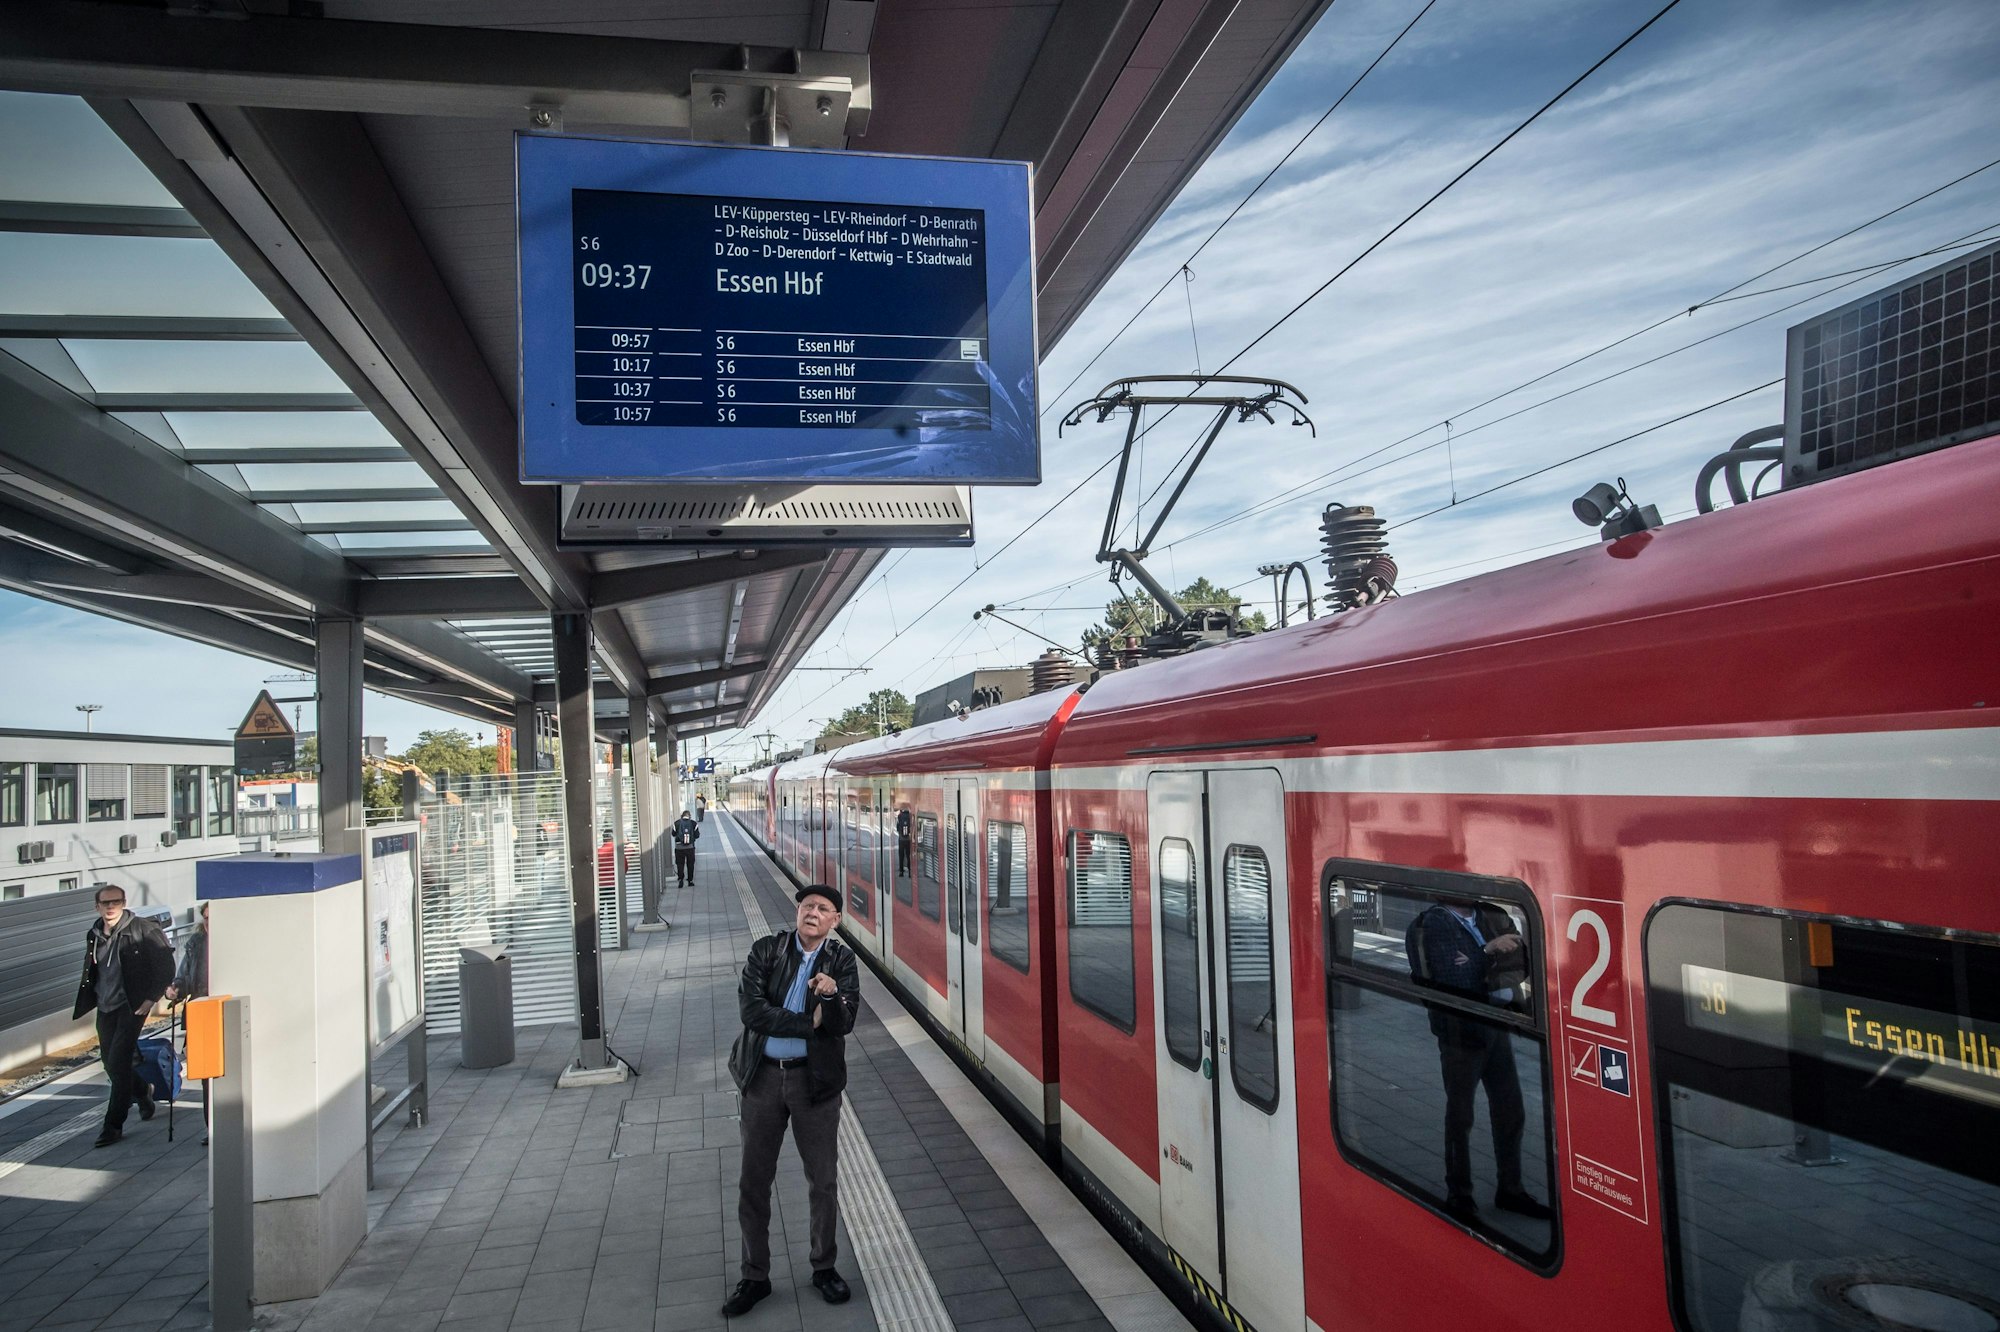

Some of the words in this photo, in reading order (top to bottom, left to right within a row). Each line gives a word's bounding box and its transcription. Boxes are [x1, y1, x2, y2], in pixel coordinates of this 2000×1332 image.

[714, 204, 810, 227] LEV-Küppersteg
[823, 210, 907, 227] LEV-Rheindorf
[919, 214, 977, 231] D-Benrath
[580, 236, 589, 250] S
[591, 236, 600, 251] 6
[726, 224, 790, 240] D-Reisholz
[802, 227, 865, 244] Düsseldorf
[867, 230, 889, 245] Hbf
[901, 232, 910, 246] D
[911, 232, 969, 248] Wehrhahn
[715, 242, 724, 256] D
[726, 242, 749, 257] Zoo
[763, 244, 837, 261] D-Derendorf
[849, 248, 894, 266] Kettwig
[906, 250, 914, 264] E
[916, 250, 972, 266] Stadtwald
[582, 262, 652, 290] 09:37
[716, 268, 778, 294] Essen
[784, 270, 824, 296] Hbf
[611, 333, 650, 349] 09:57
[716, 335, 724, 350] S
[726, 336, 735, 350] 6
[797, 338, 831, 353] Essen
[833, 339, 855, 353] Hbf
[613, 357, 651, 373] 10:17
[716, 359, 725, 374] S
[727, 360, 736, 374] 6
[798, 362, 832, 376] Essen
[834, 362, 856, 377] Hbf
[613, 382, 651, 397] 10:37
[717, 383, 725, 398] S
[727, 384, 736, 398] 6
[798, 385, 832, 400] Essen
[834, 386, 856, 401] Hbf
[613, 406, 651, 422] 10:57
[717, 408, 726, 422] S
[728, 408, 737, 422] 6
[799, 409, 833, 424] Essen
[835, 410, 857, 424] Hbf
[704, 759, 712, 770] 2
[1567, 909, 1617, 1027] 2
[1699, 977, 1727, 1016] S6
[1845, 1007, 1946, 1065] Essen
[1179, 1155, 1194, 1174] BAHN
[1576, 1160, 1603, 1183] Einstieg
[1604, 1174, 1617, 1186] nur
[1577, 1174, 1589, 1187] mit
[1589, 1177, 1633, 1206] Fahrausweis
